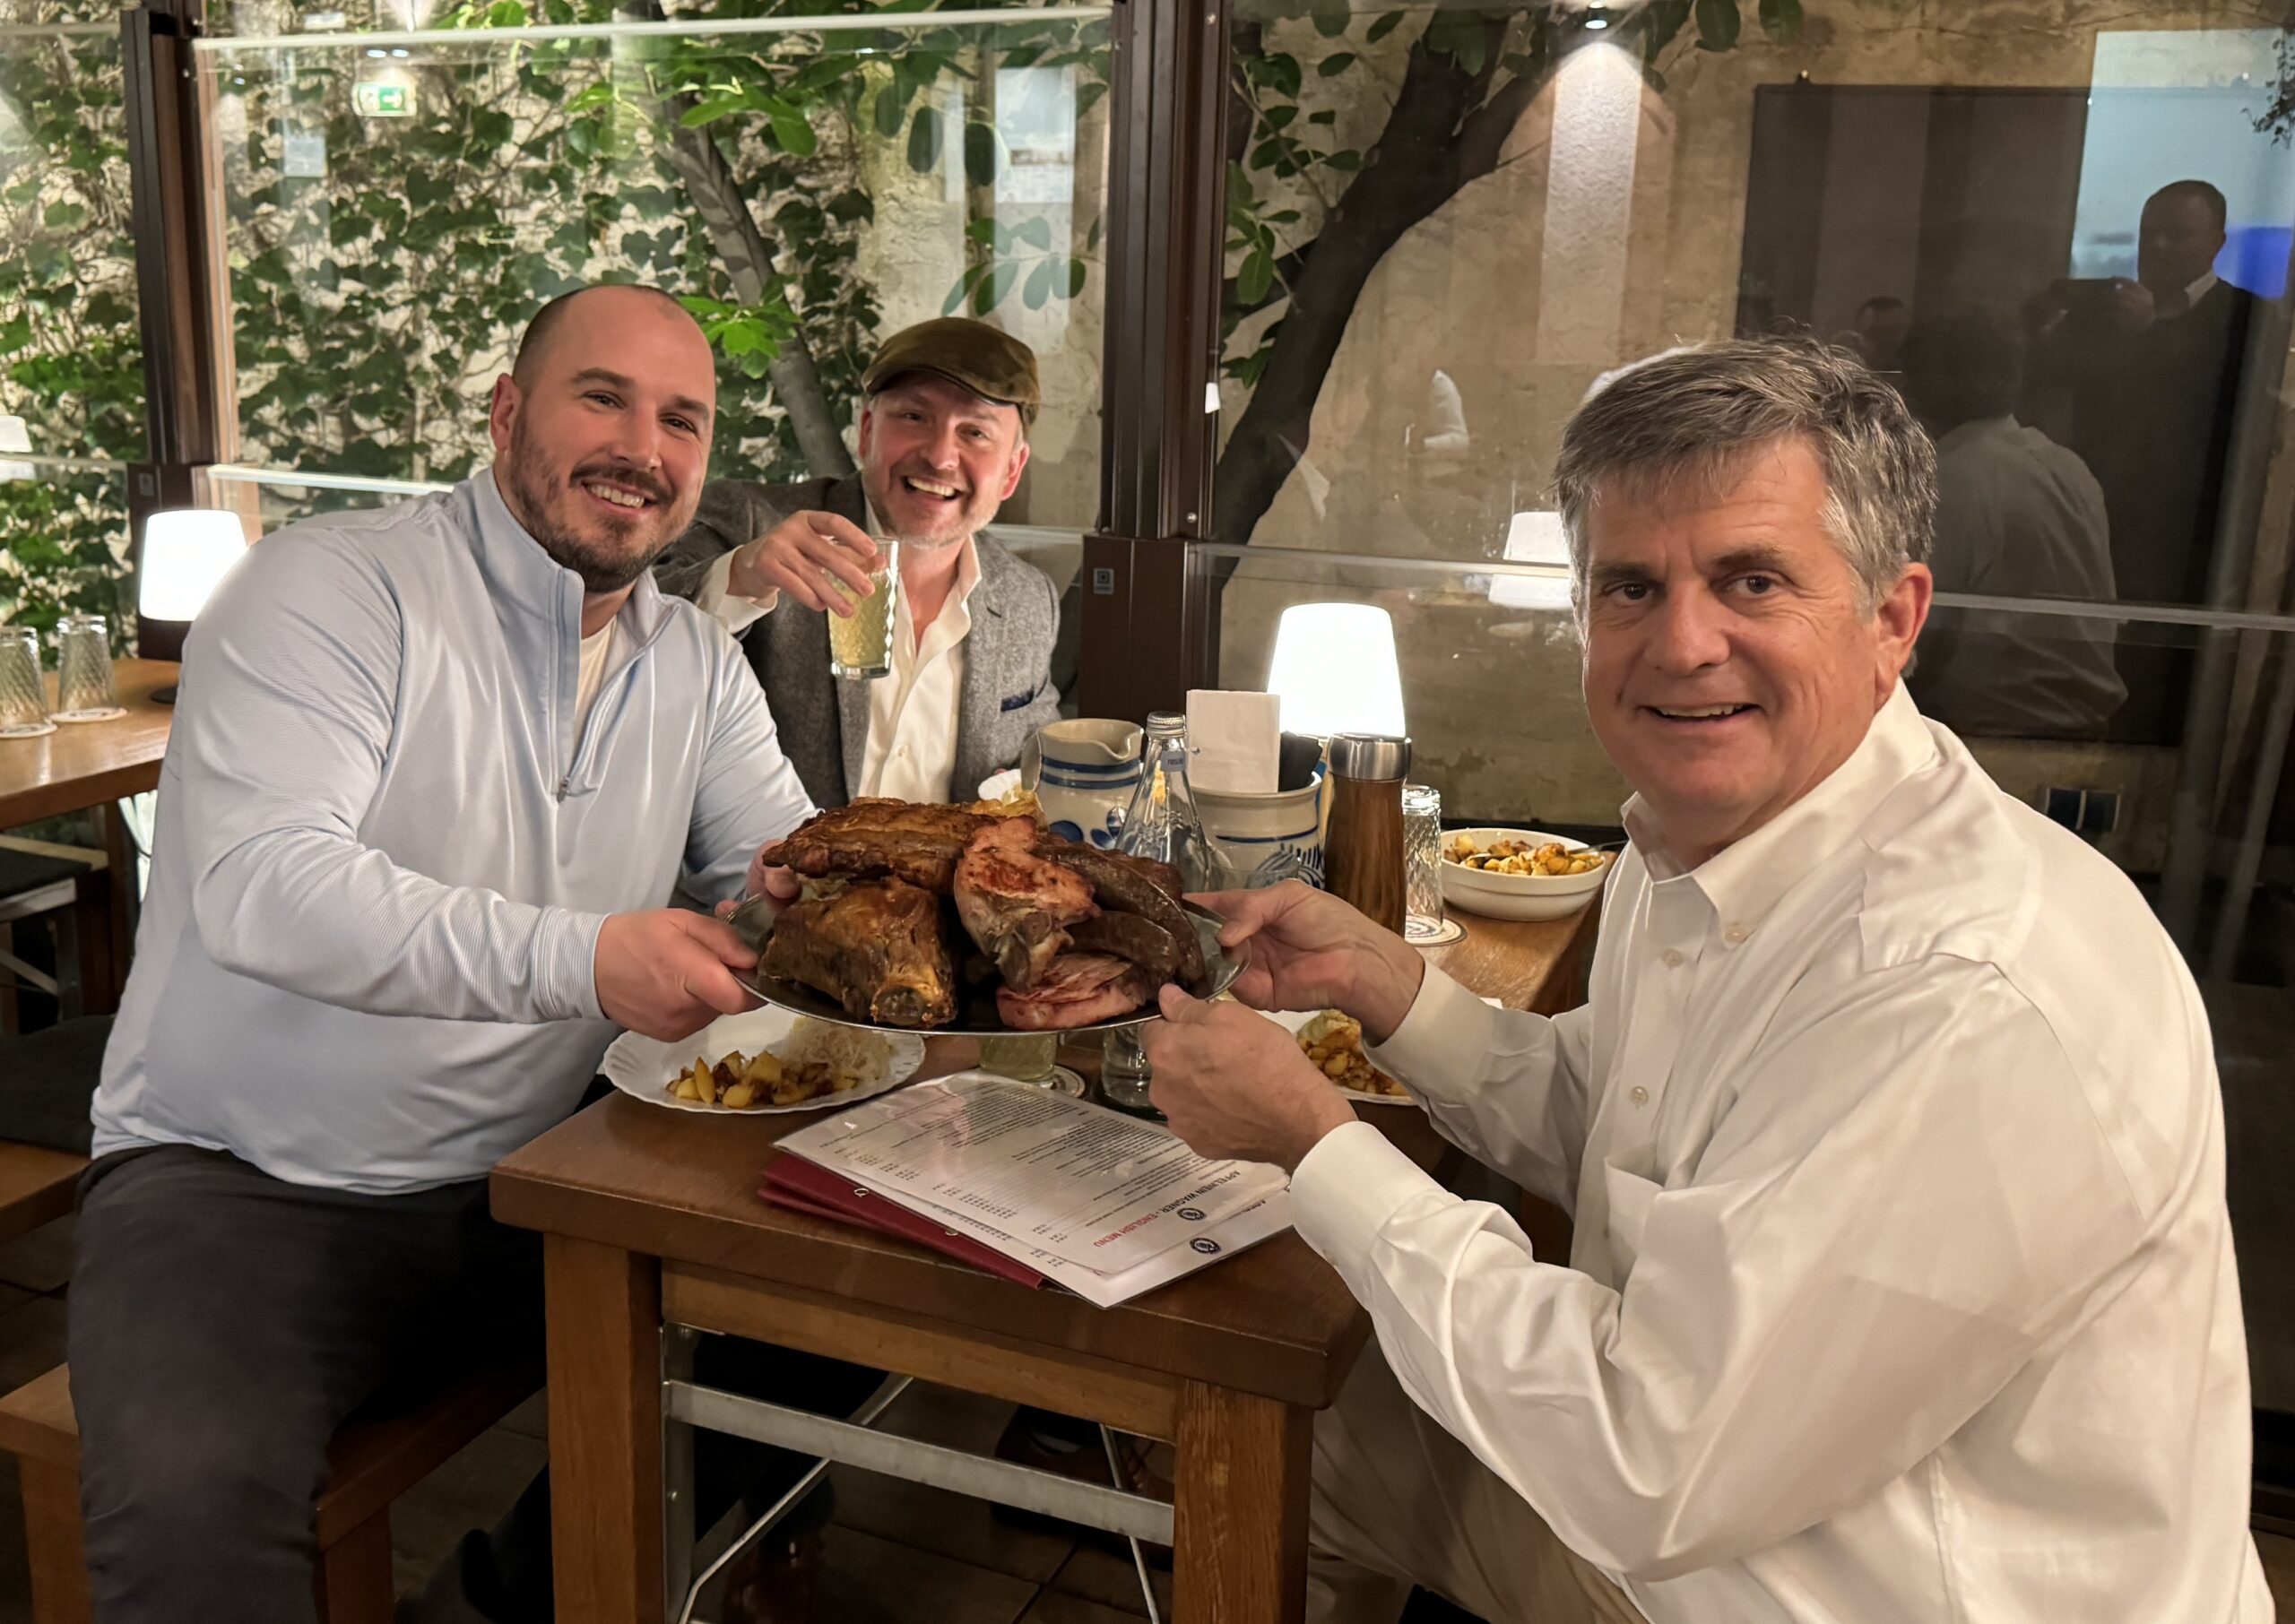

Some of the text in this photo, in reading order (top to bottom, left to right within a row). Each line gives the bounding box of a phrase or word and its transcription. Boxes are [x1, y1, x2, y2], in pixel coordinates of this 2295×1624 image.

[1195, 1170, 1241, 1195] APFELWEIN
[1160, 1193, 1199, 1213] WAGNER
[1119, 1214, 1158, 1234] ENGLISH
[1094, 1231, 1122, 1248] MENU
